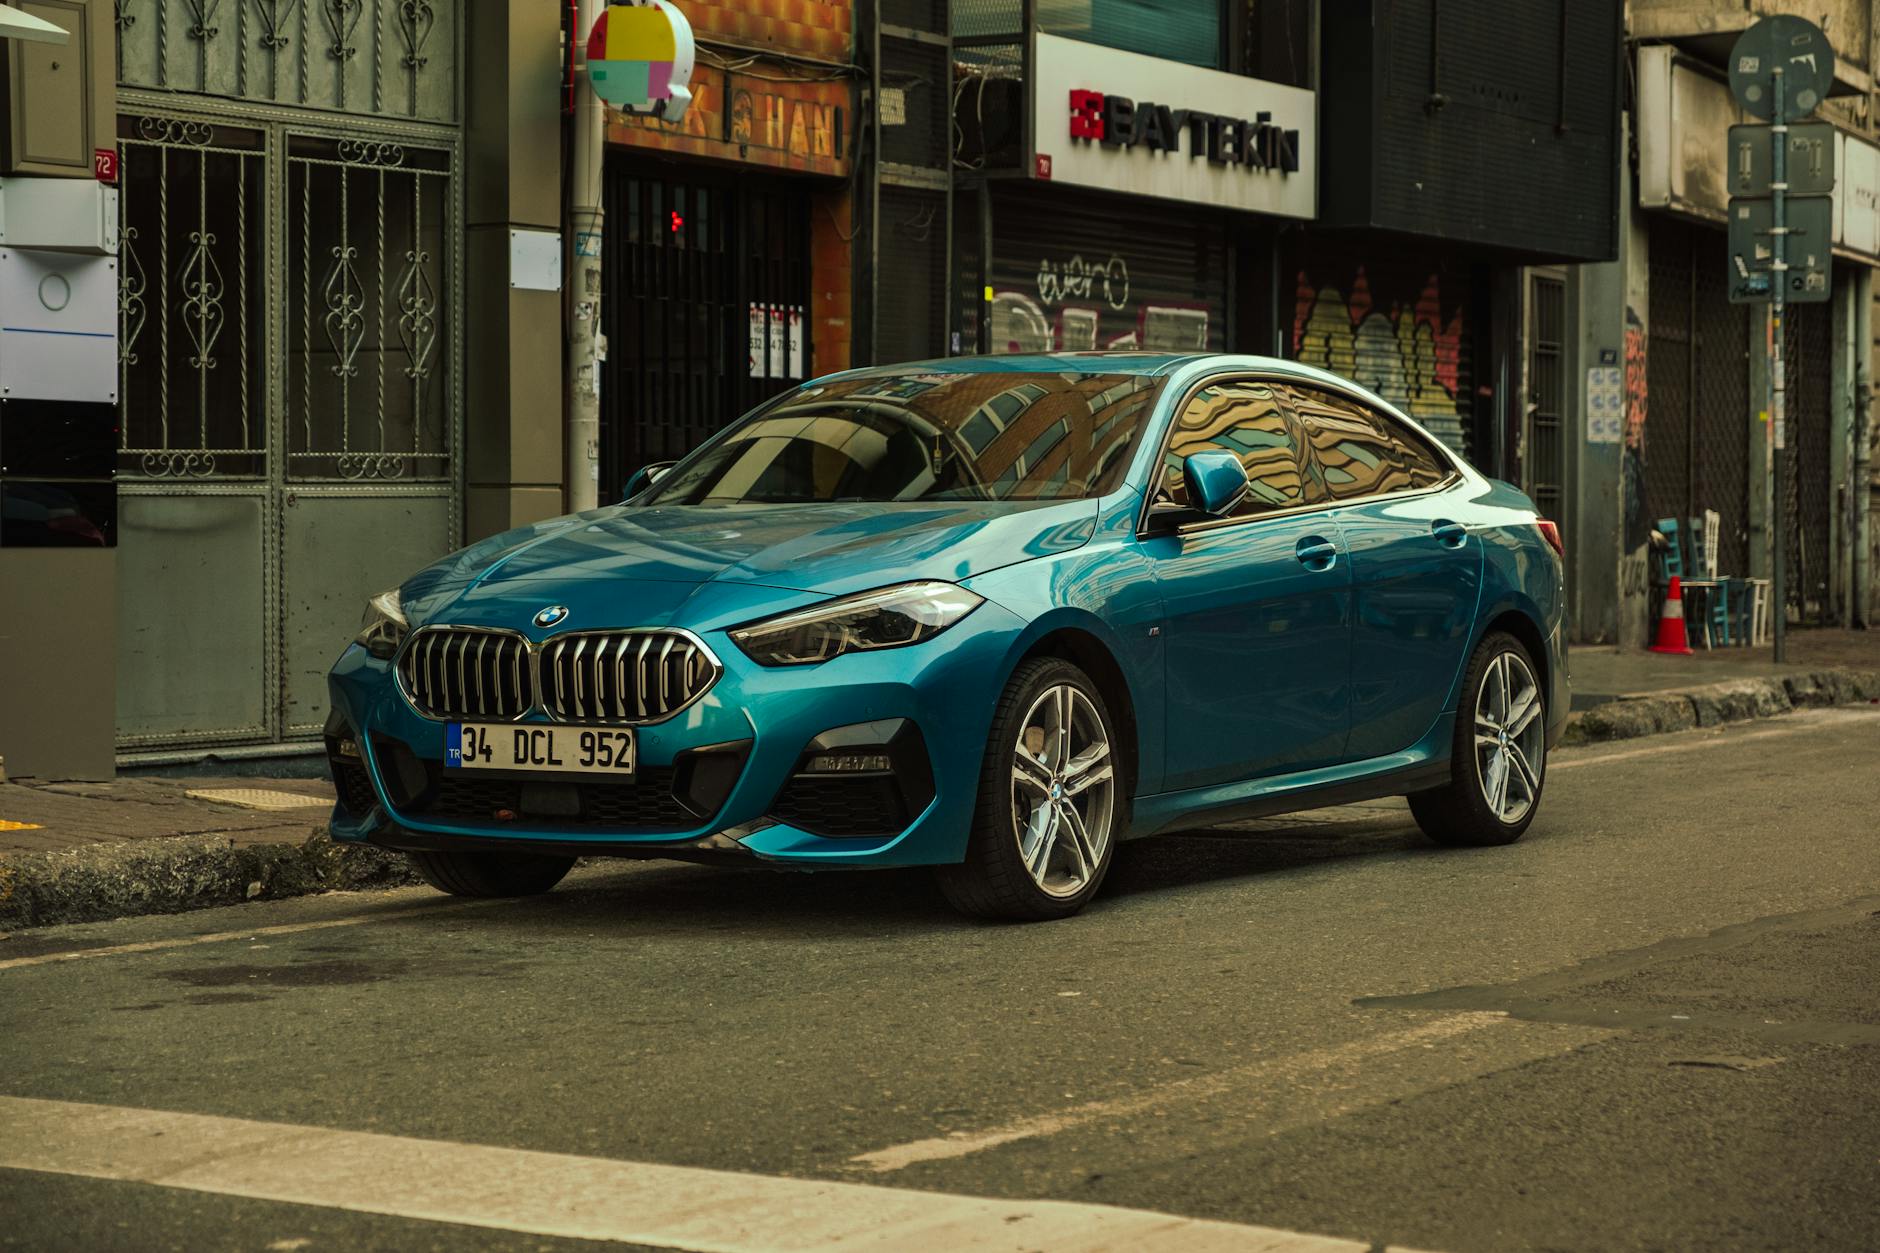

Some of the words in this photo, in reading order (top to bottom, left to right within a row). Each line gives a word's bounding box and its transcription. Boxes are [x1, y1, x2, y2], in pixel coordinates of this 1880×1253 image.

[1101, 95, 1299, 173] BAYTEKİN
[96, 155, 111, 174] 72
[449, 748, 461, 759] TR
[462, 727, 493, 763] 34
[514, 729, 563, 766] DCL
[580, 731, 631, 768] 952
